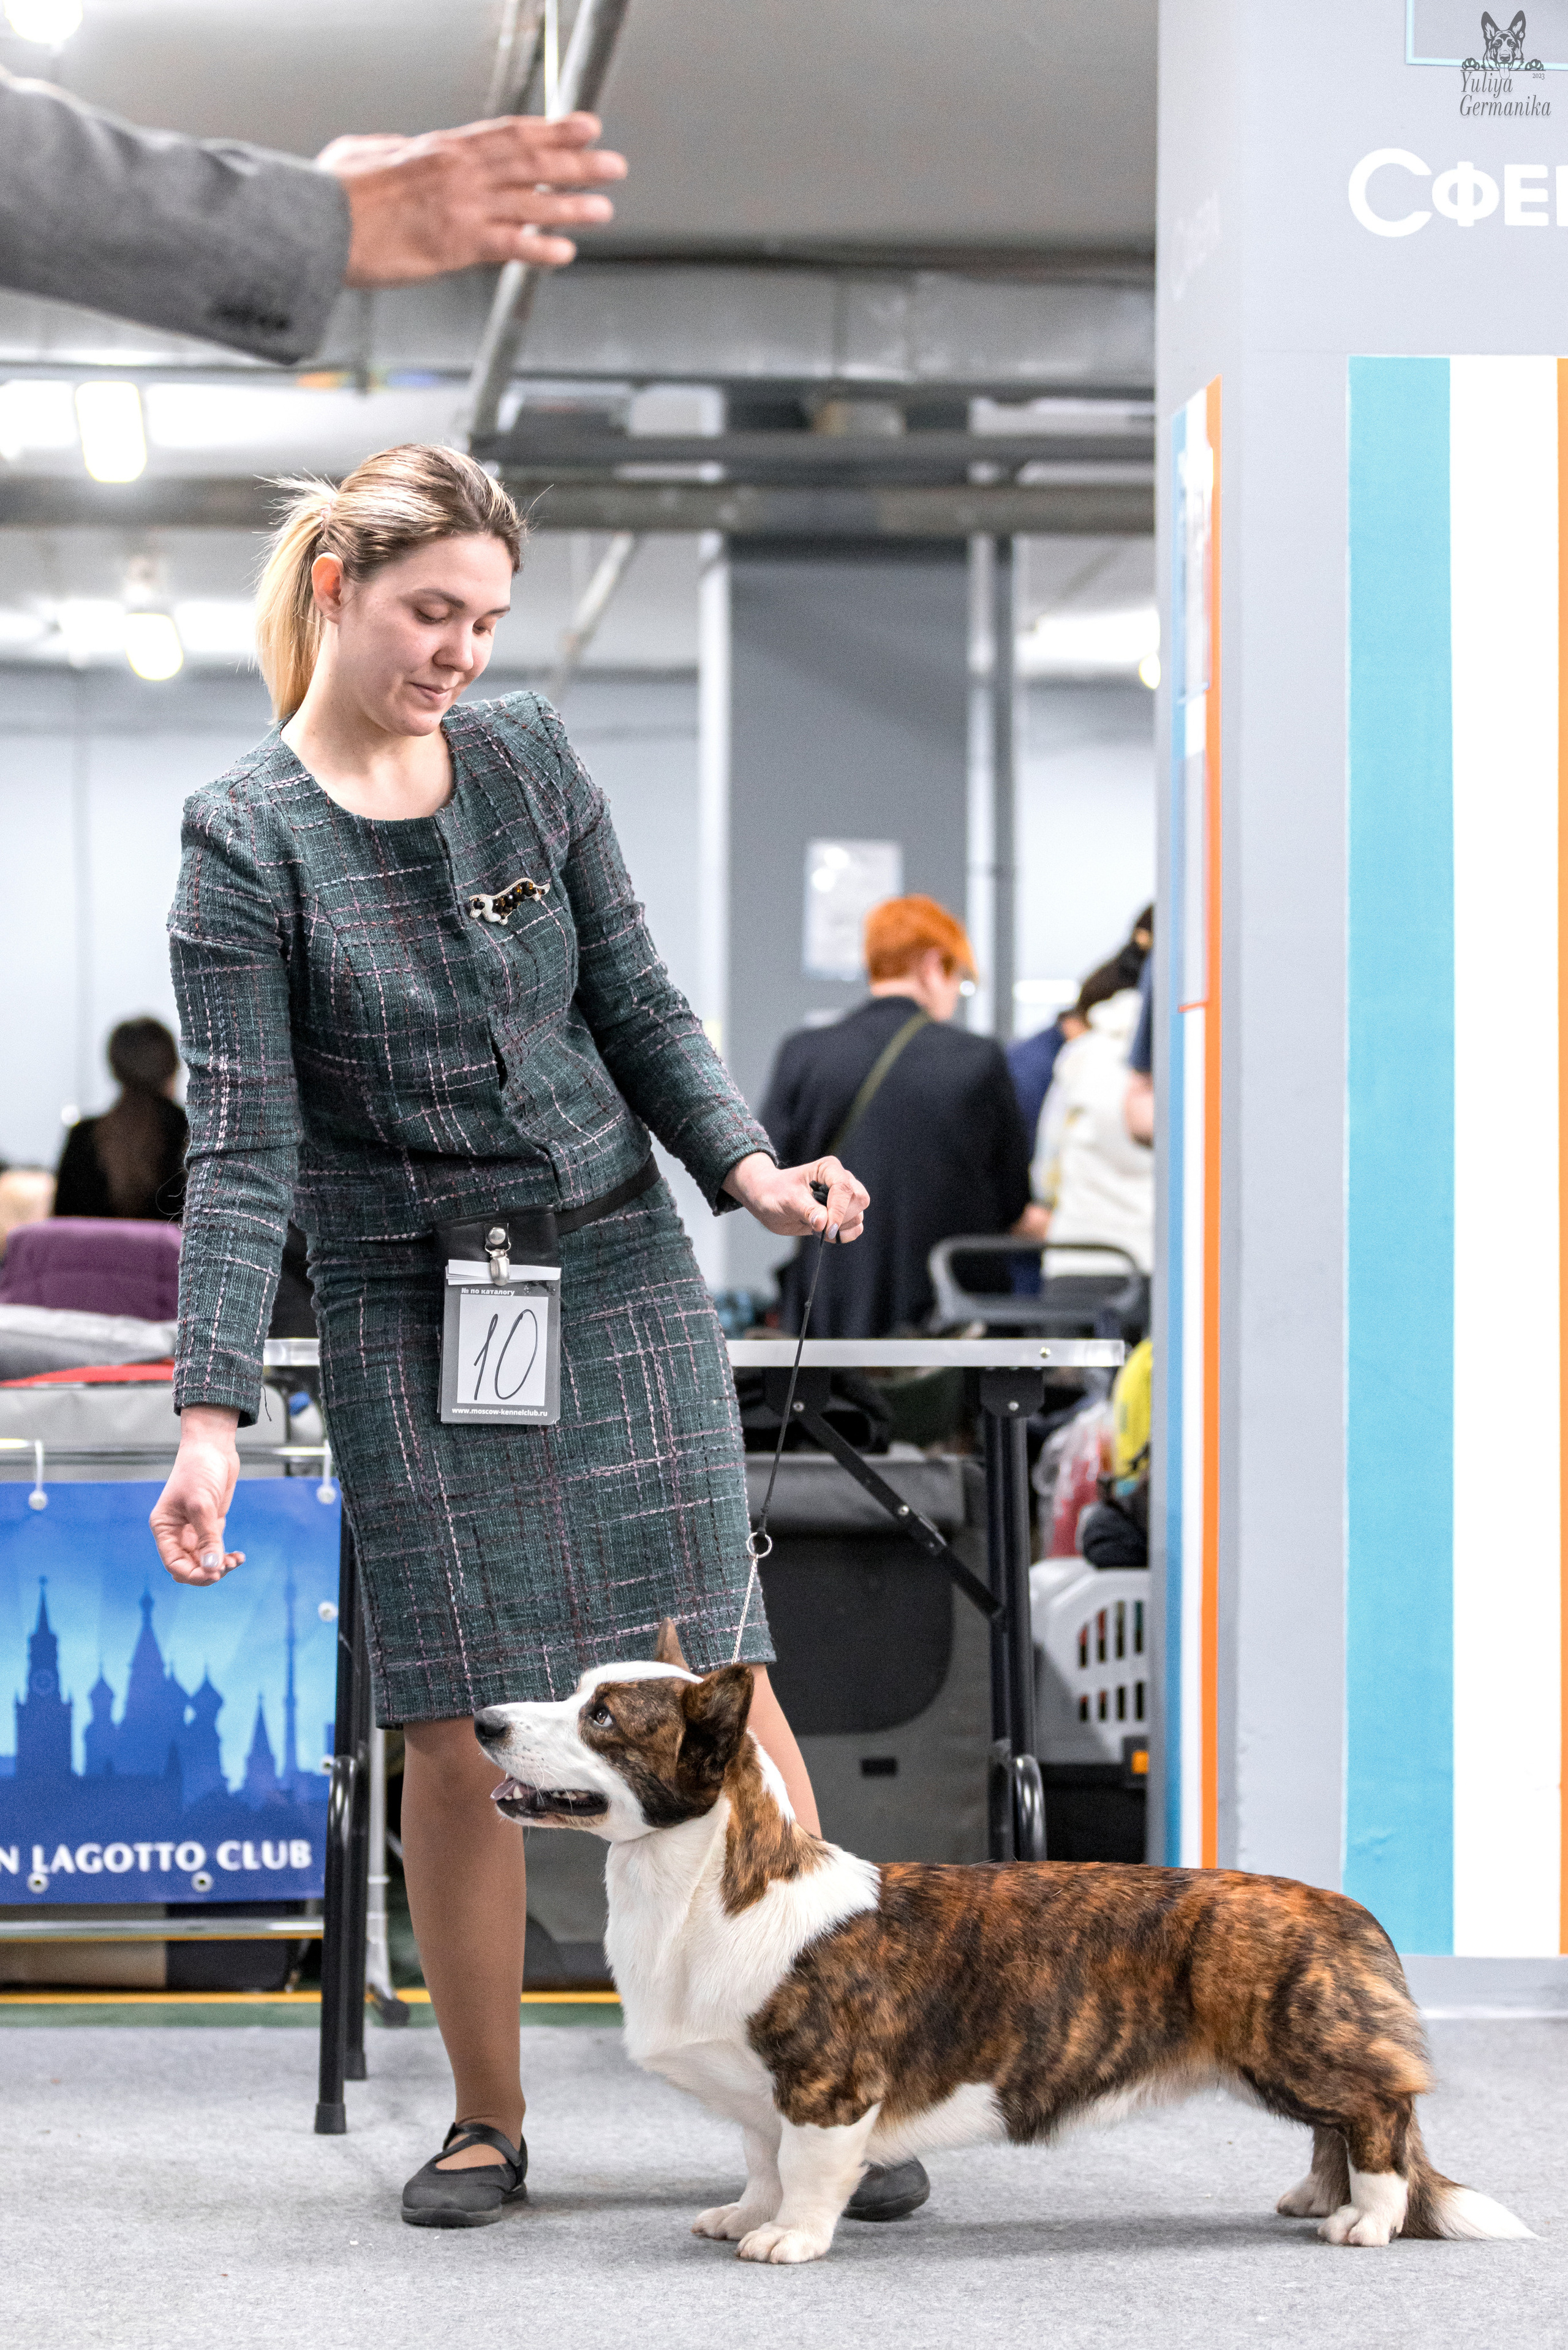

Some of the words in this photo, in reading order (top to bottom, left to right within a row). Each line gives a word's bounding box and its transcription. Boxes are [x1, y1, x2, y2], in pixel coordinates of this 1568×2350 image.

[473, 1309, 538, 1400] 10
[452, 1408, 548, 1417] www.moscow-kennelclub.ru
[32, 1842, 206, 1874] LAGOTTO
[216, 1840, 312, 1872] CLUB
